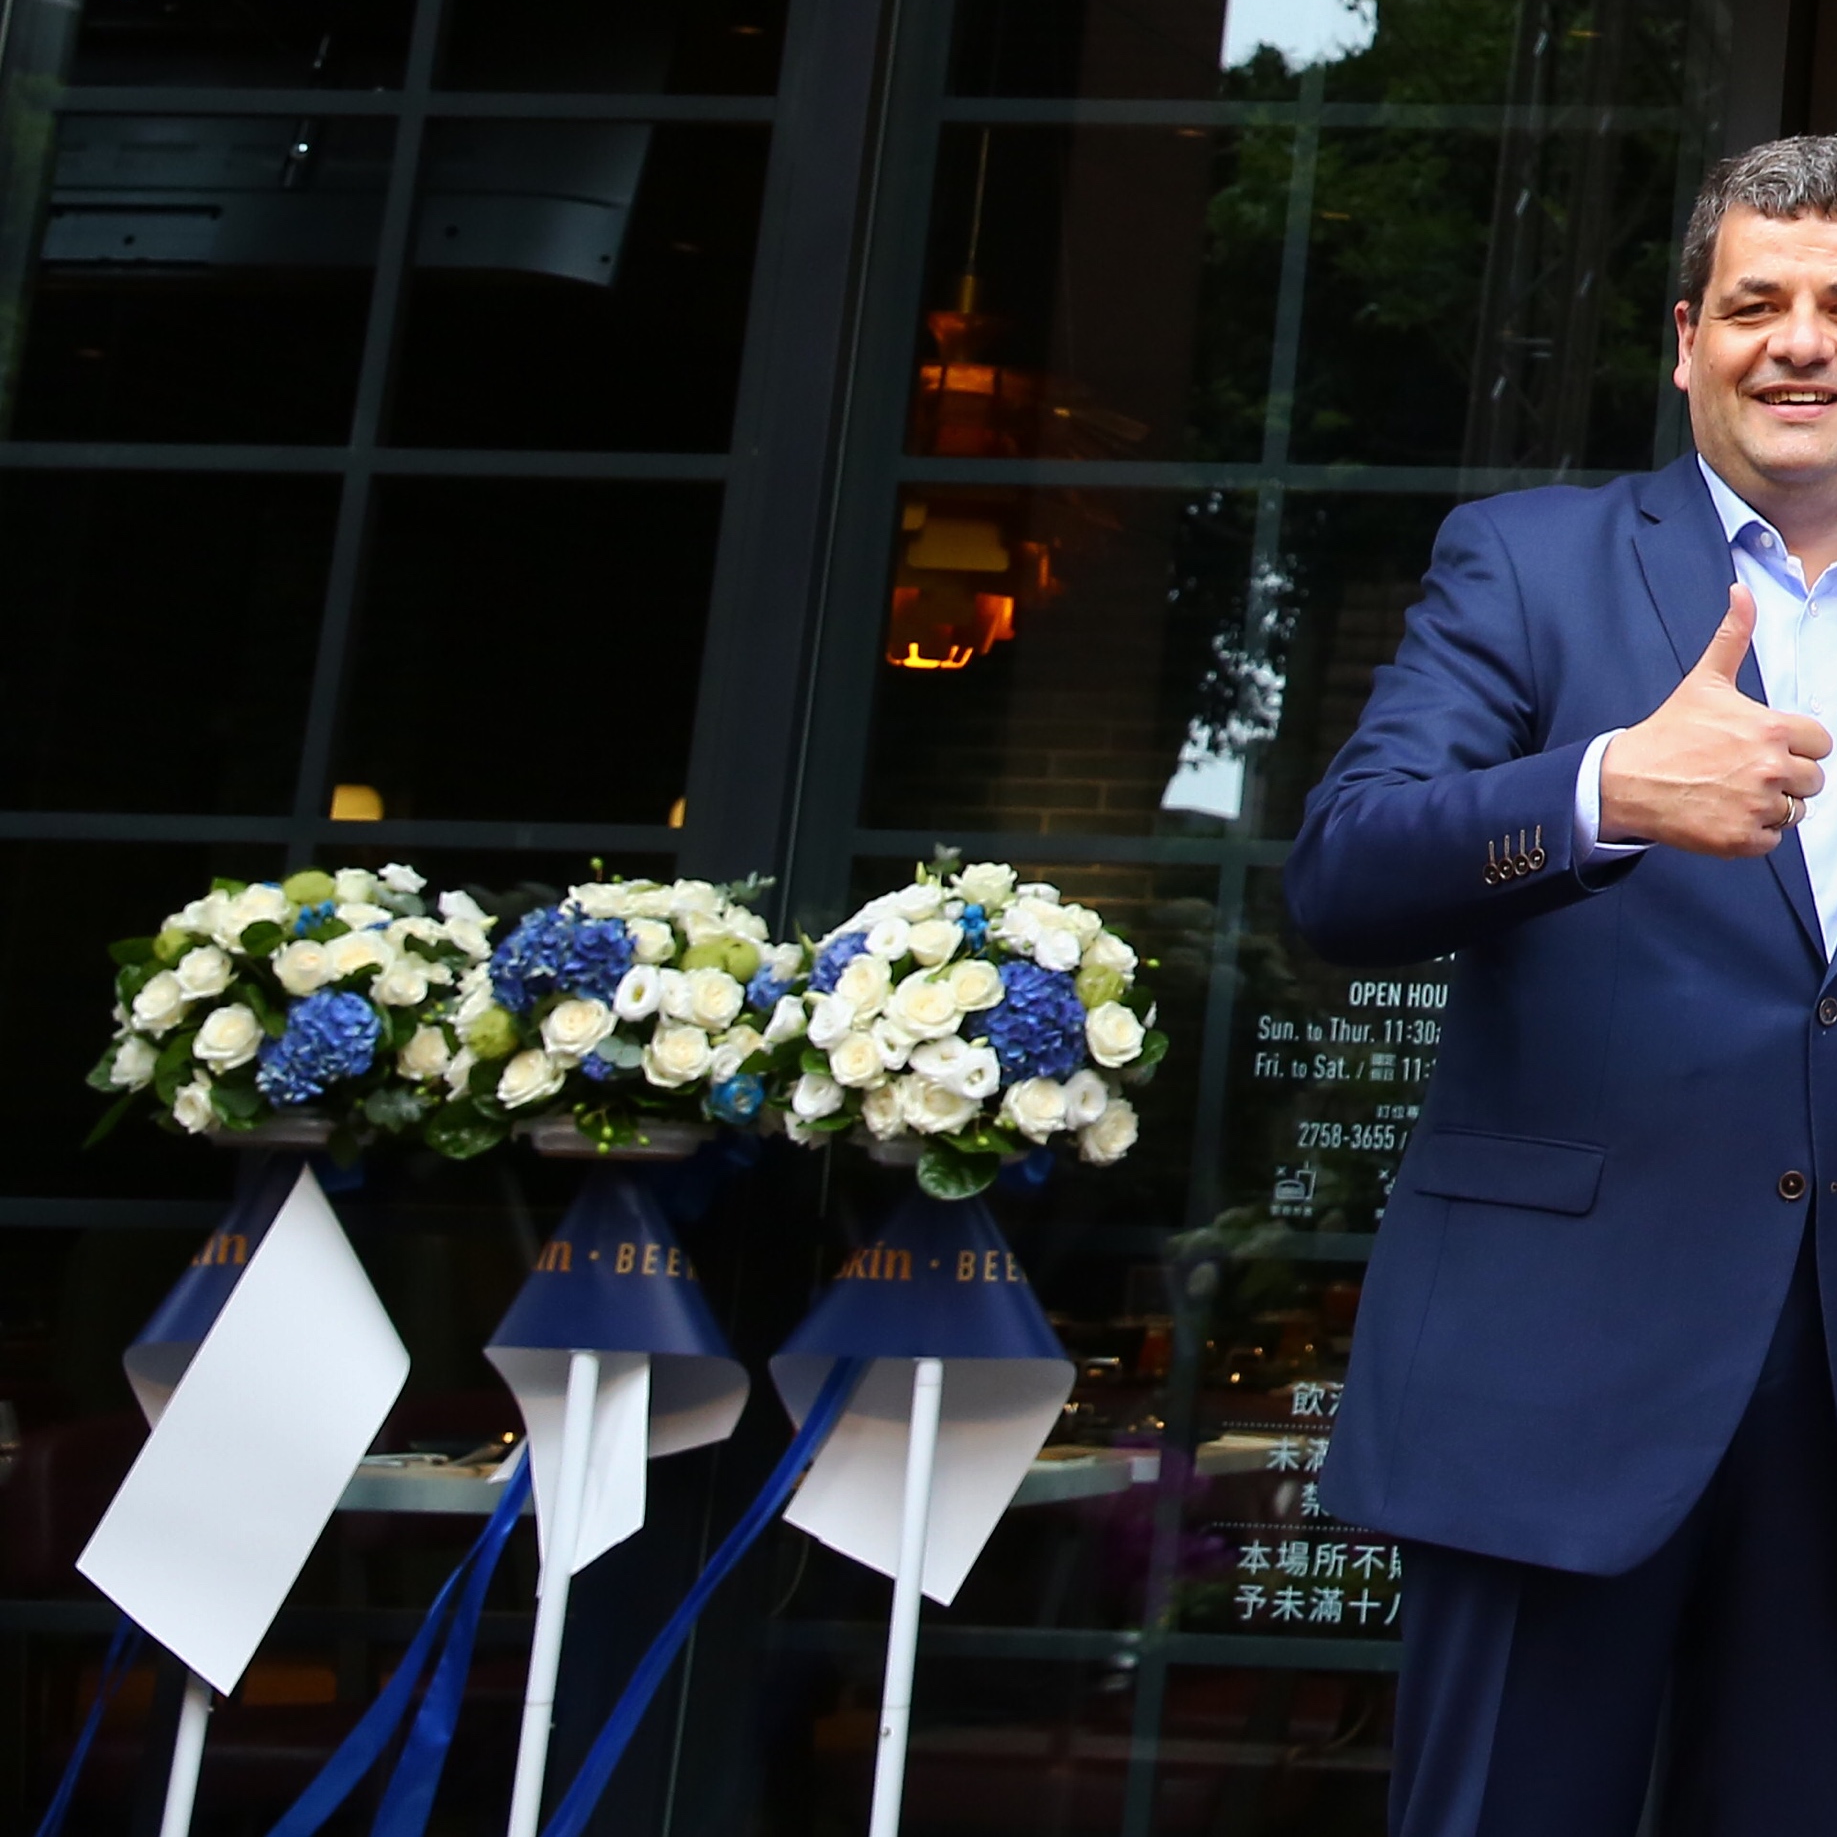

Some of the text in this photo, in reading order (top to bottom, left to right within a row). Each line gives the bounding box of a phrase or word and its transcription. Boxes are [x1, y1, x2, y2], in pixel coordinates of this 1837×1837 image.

[1349, 981, 1401, 1007] OPEN
[1257, 1015, 1299, 1041] Sun.
[1306, 1022, 1322, 1041] to
[1330, 1017, 1375, 1043] Thur.
[1254, 1052, 1284, 1078] Fri.
[1291, 1060, 1307, 1079] to
[1313, 1054, 1350, 1080] Sat.
[1298, 1122, 1395, 1150] 2758-3655
